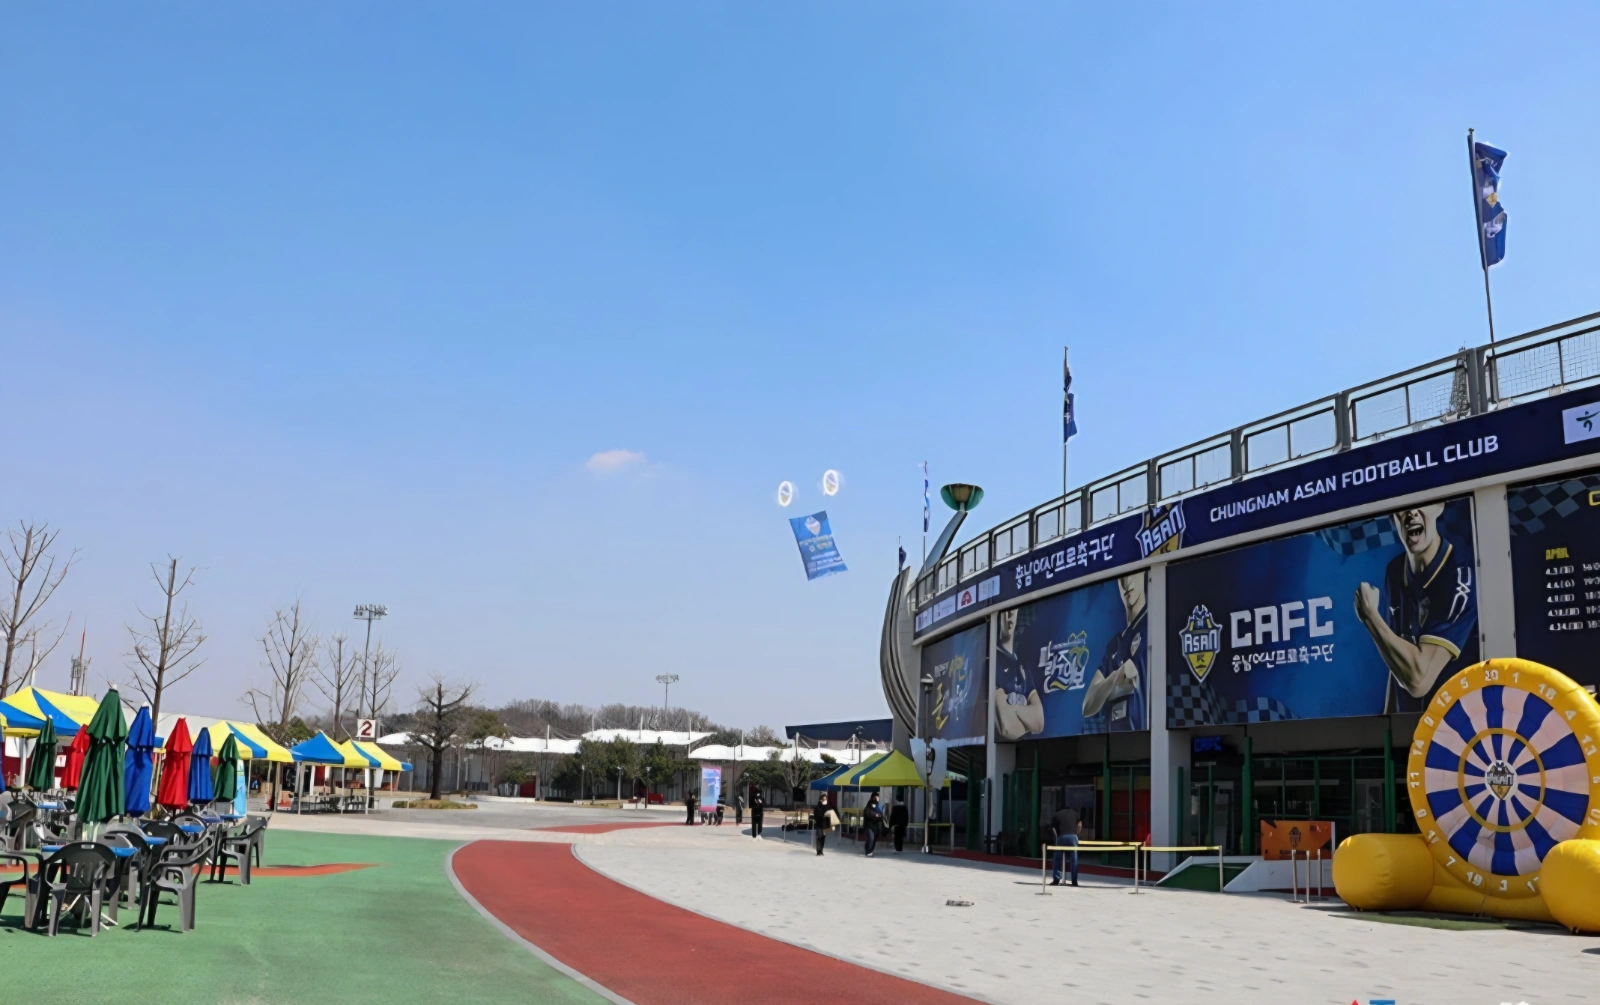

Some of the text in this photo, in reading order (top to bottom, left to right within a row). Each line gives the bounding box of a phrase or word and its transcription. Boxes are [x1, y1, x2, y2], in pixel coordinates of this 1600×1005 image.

[1209, 434, 1500, 523] CHUNGNAM ASAN FOOTBALL CLUB
[1141, 504, 1184, 556] ASAN
[1230, 596, 1335, 648] CAFC
[1184, 629, 1219, 653] ASAN
[1512, 671, 1520, 684] 1
[361, 720, 372, 736] 2
[1446, 855, 1456, 867] 7
[1500, 879, 1508, 891] 3
